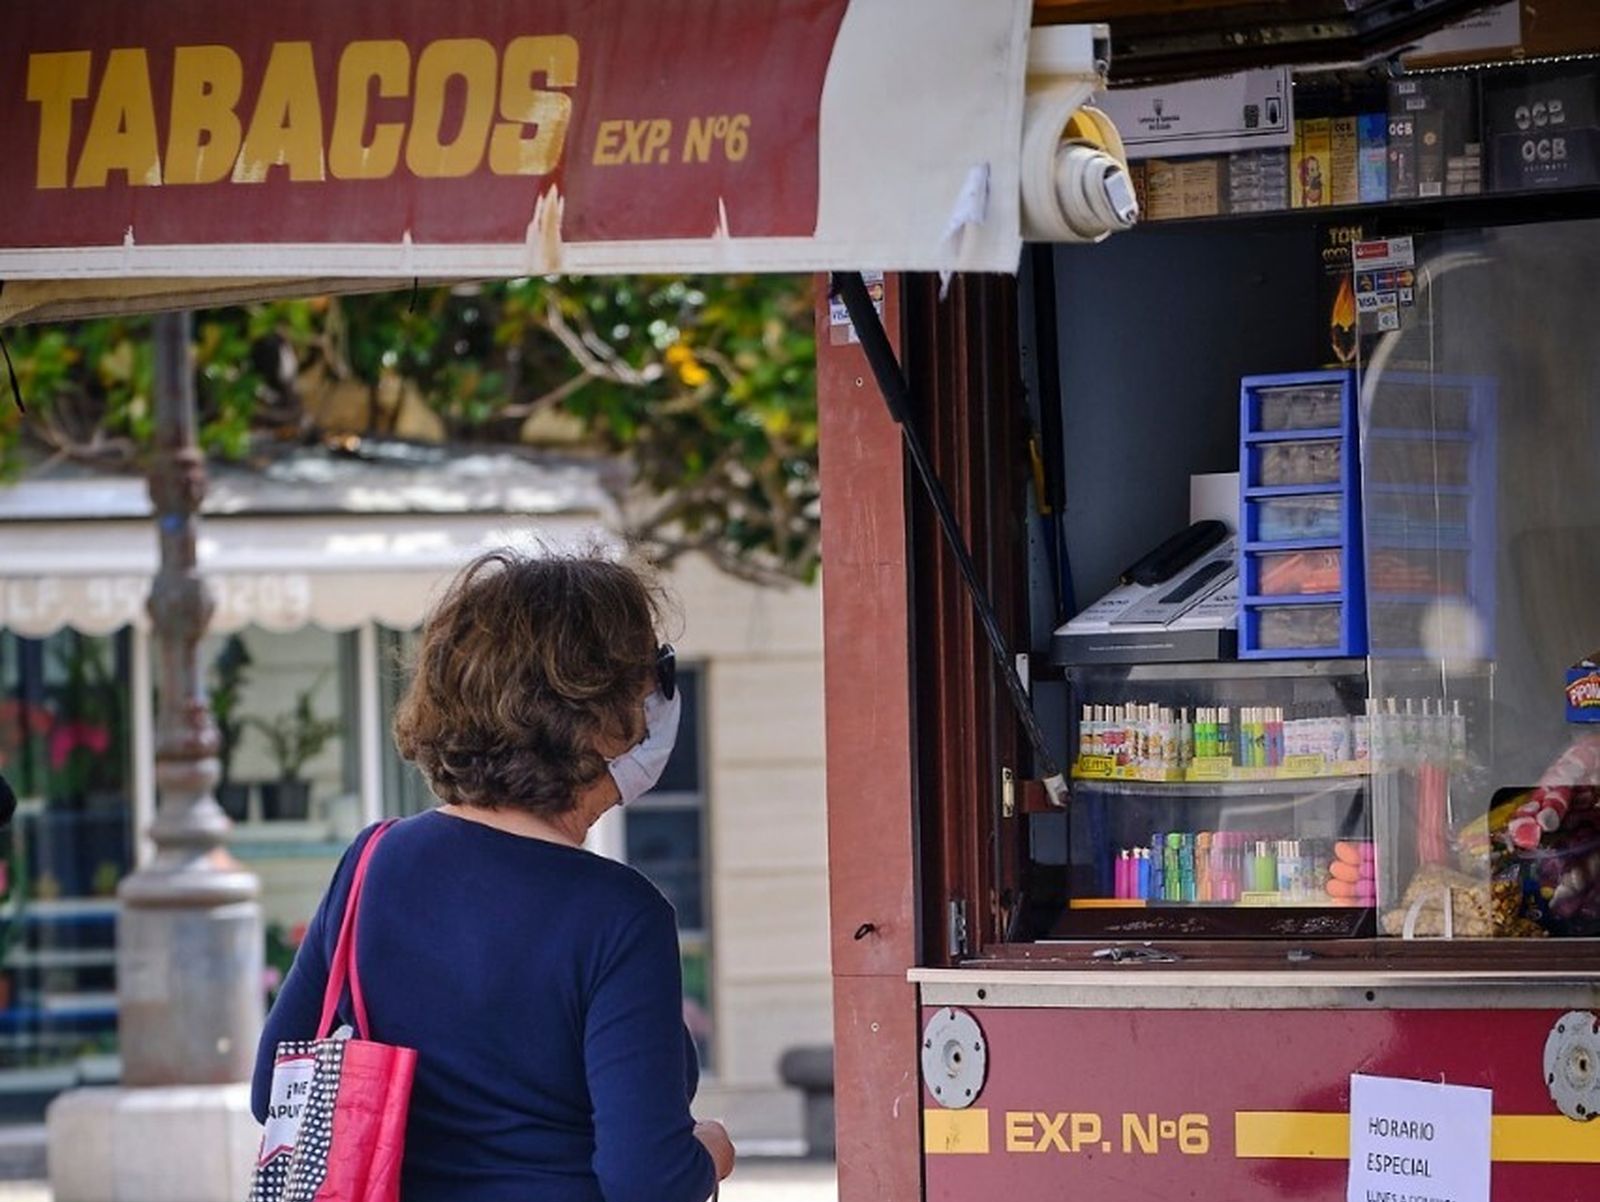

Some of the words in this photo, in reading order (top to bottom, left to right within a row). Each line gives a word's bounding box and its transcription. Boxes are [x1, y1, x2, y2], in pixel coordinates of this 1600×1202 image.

[27, 34, 579, 189] TABACOS
[592, 119, 671, 166] EXP.
[1515, 100, 1565, 130] OCB
[1389, 122, 1413, 136] OCB
[1521, 138, 1566, 162] OCB
[1005, 1111, 1111, 1152] EXP.
[1368, 1117, 1435, 1141] HORARIO
[1366, 1152, 1432, 1178] ESPECIAL
